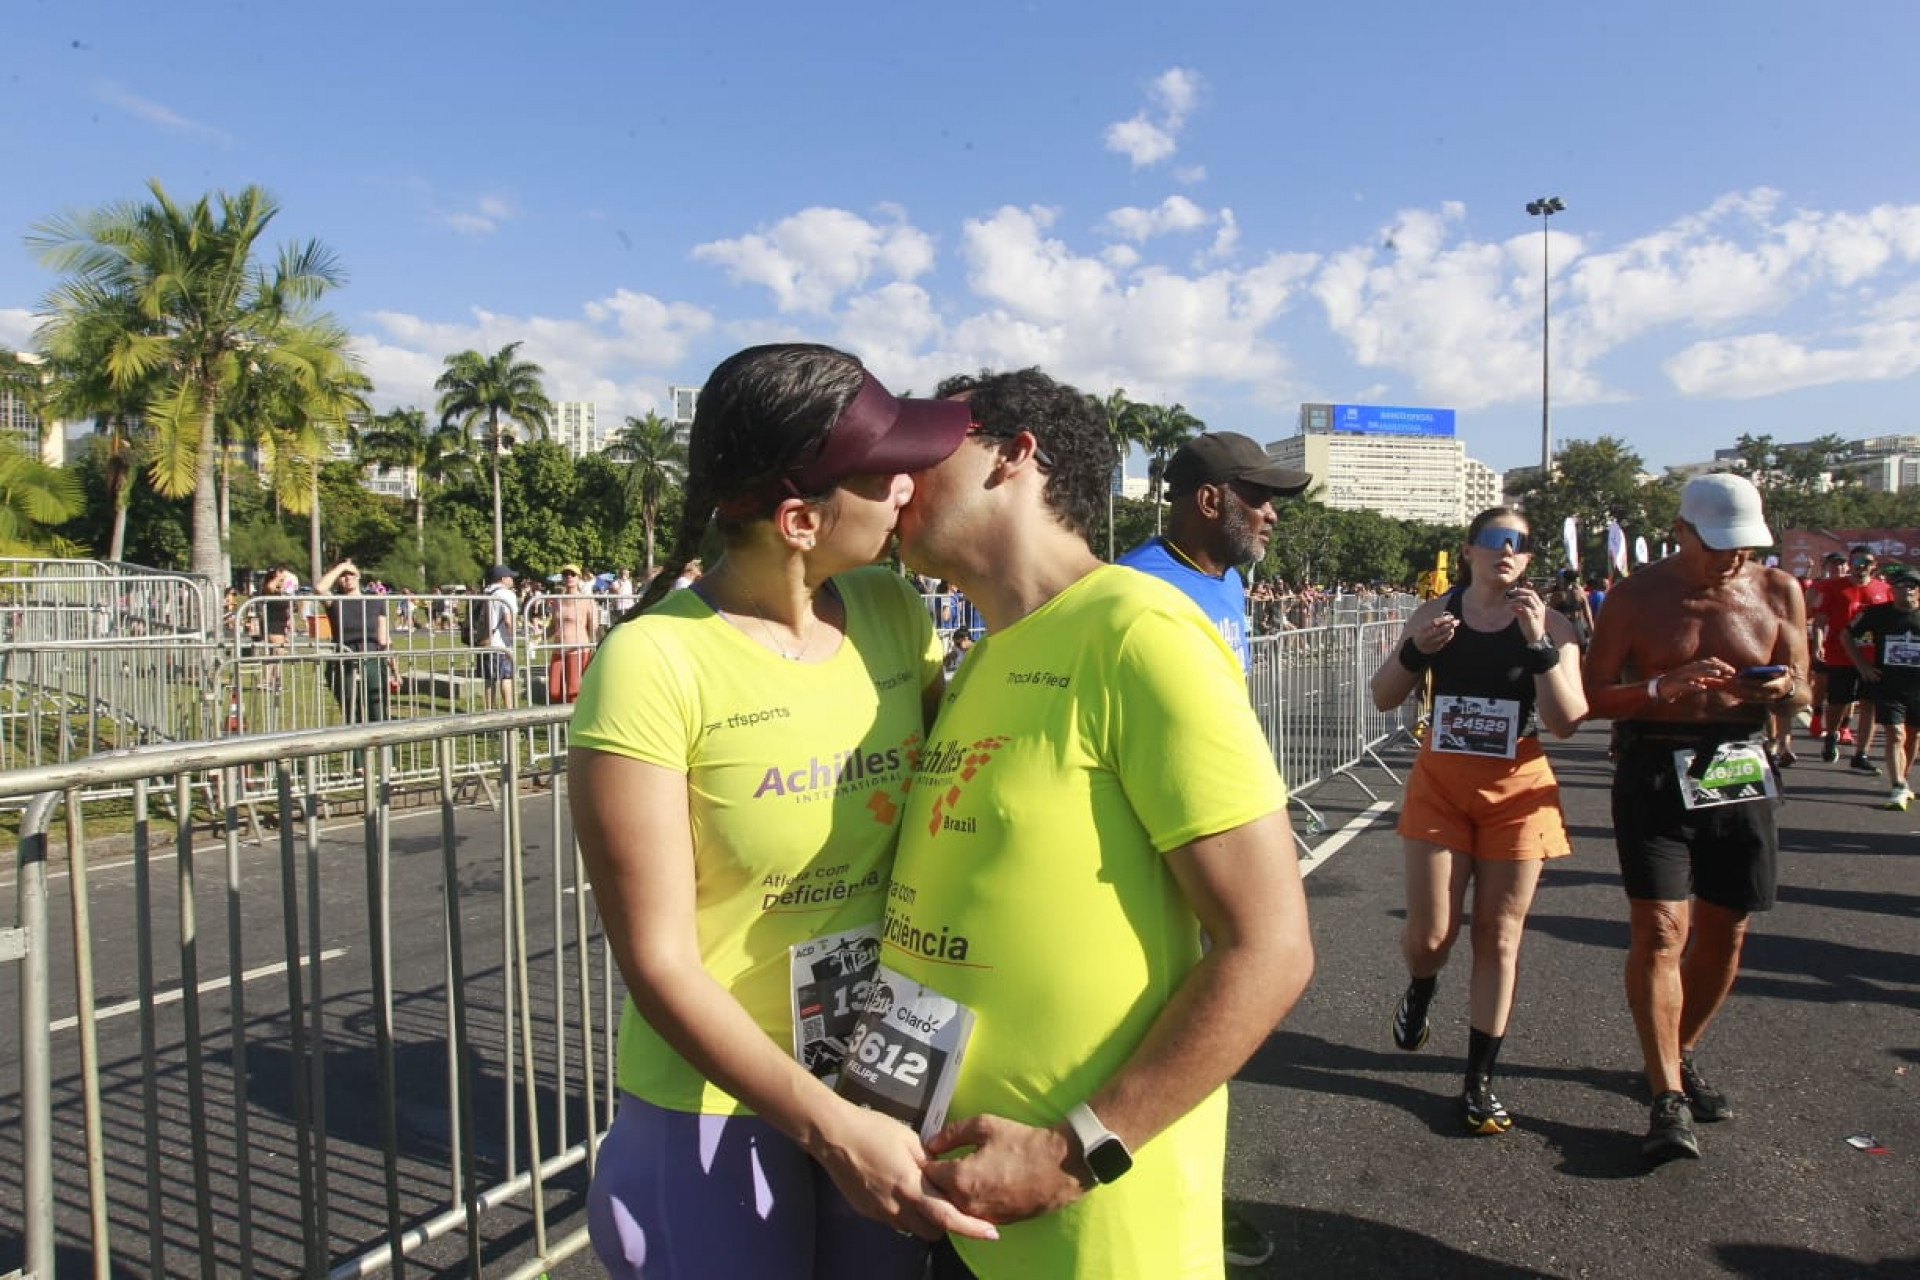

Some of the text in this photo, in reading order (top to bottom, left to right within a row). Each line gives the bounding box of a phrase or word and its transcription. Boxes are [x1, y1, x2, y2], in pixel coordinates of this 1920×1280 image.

[727, 706, 791, 728] tfsports
[1452, 716, 1507, 733] 24529
[753, 747, 901, 799] Achilles
[943, 815, 977, 833] Brazil
[896, 1006, 931, 1033] Claro
